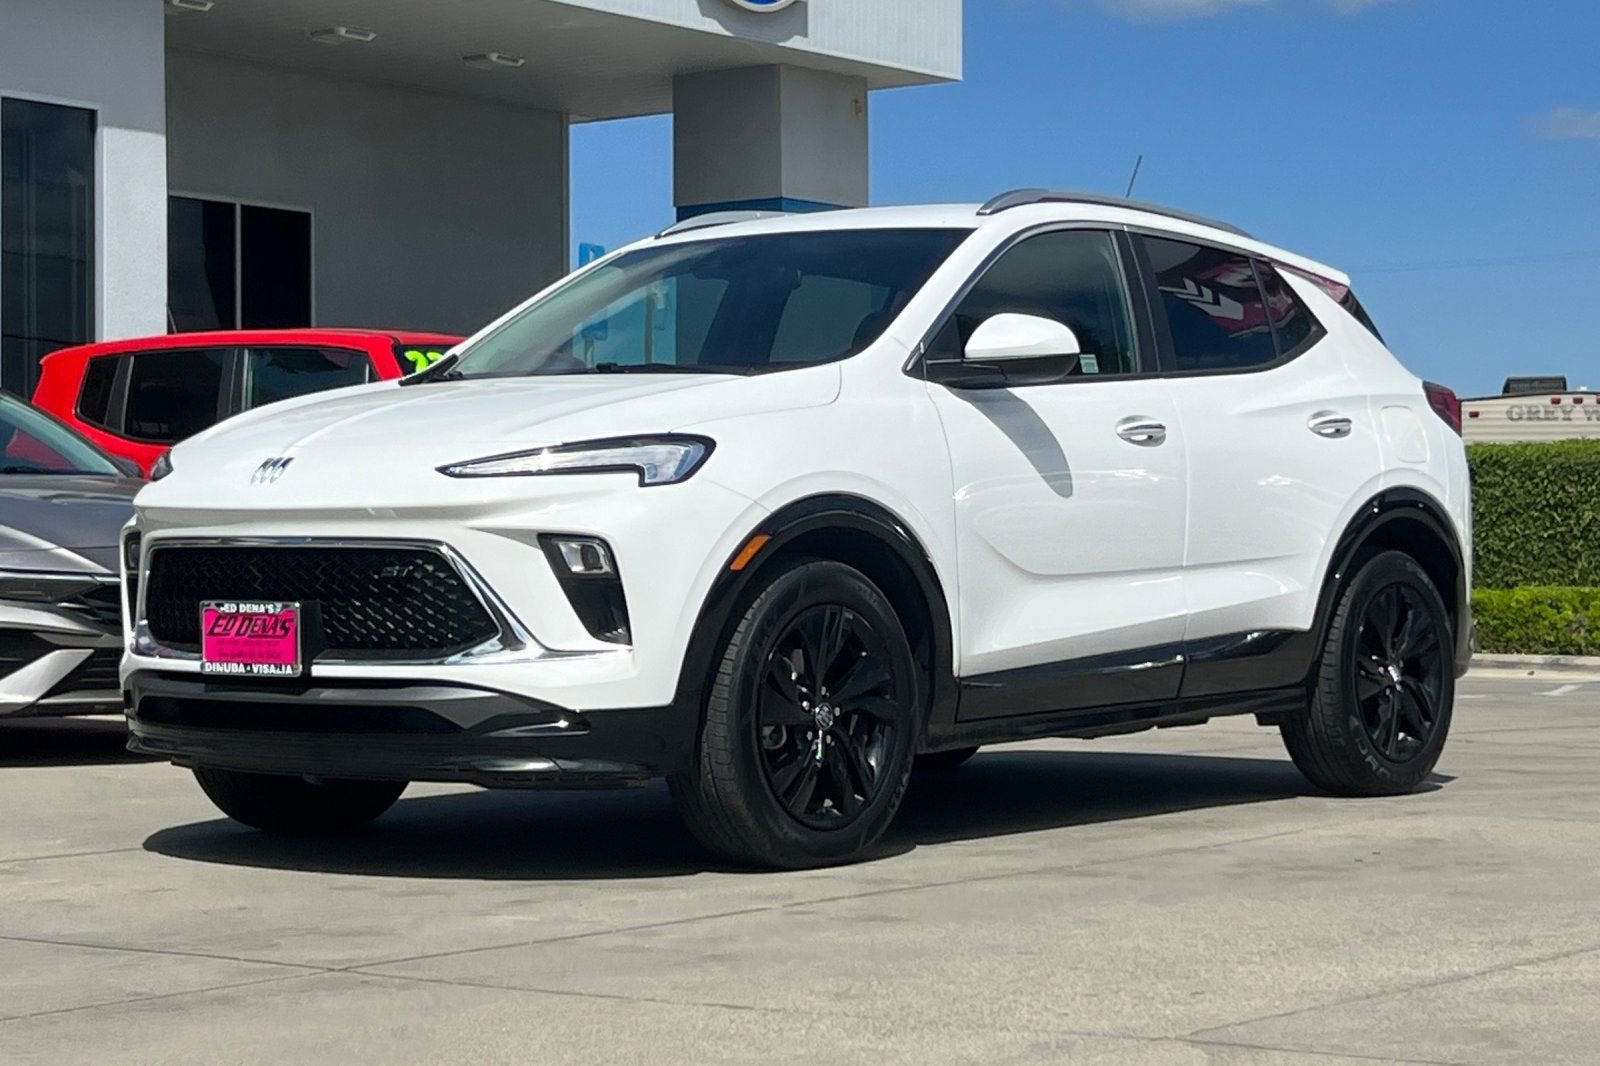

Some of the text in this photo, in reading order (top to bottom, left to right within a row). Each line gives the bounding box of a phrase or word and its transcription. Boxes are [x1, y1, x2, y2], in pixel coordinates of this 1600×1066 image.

[1505, 405, 1576, 421] GREY
[224, 603, 237, 613] ED
[207, 614, 238, 636] ED
[204, 662, 245, 673] DINUBA
